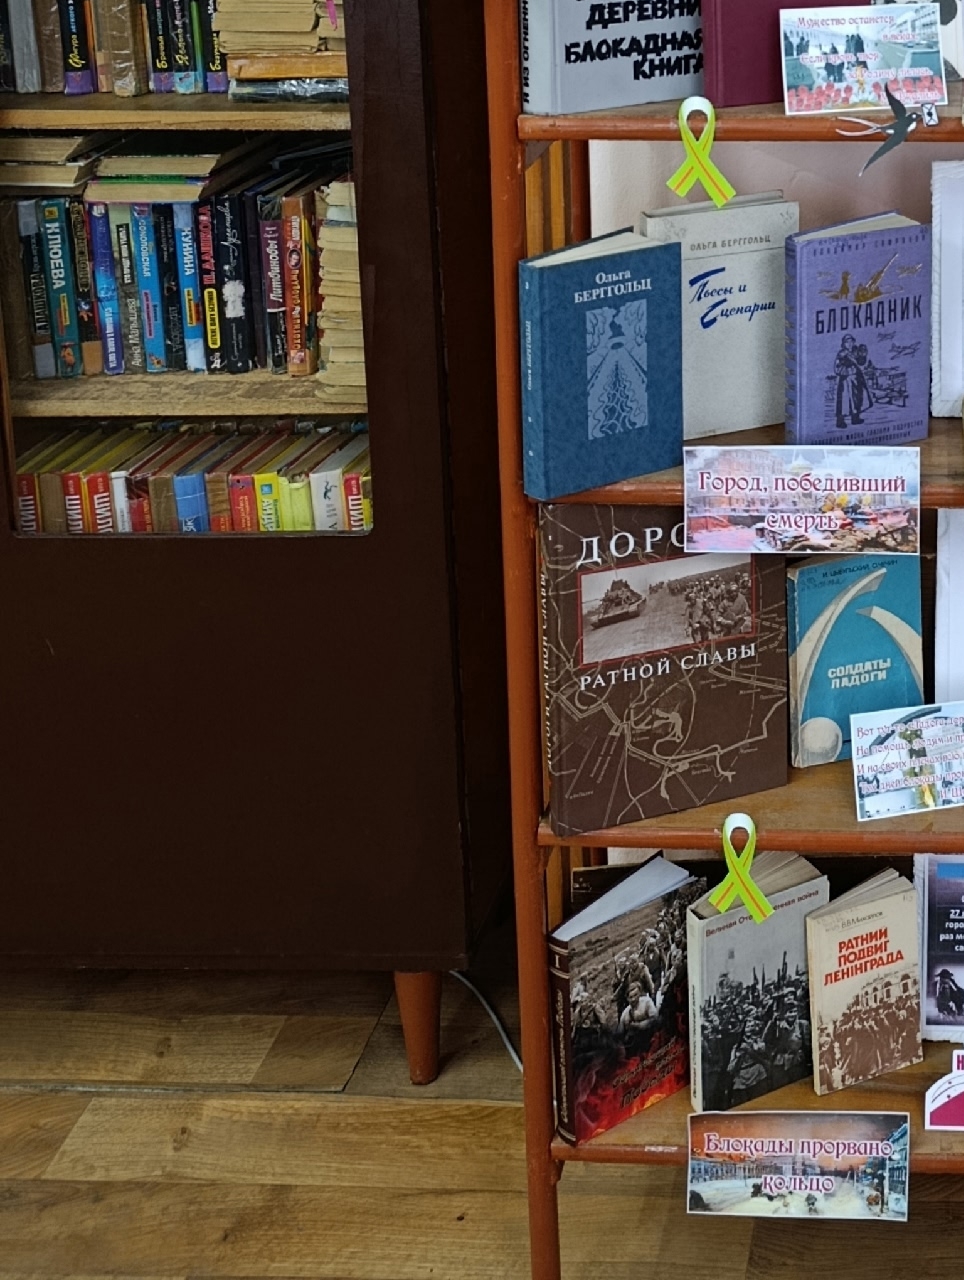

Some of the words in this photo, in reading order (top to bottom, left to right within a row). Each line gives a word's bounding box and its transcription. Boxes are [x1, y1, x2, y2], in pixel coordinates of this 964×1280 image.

[797, 18, 846, 30] Мужество
[68, 34, 86, 68] Фигура
[521, 67, 531, 86] ИЗ
[522, 92, 531, 104] Я
[199, 206, 215, 271] ДАШКОВА
[689, 239, 719, 252] ОЛЬГА
[719, 234, 771, 250] БЕРГГОЛЬЦ
[45, 222, 67, 290] КЛЮЕВА
[594, 268, 631, 288] Ольга
[688, 266, 735, 305] Пьесы
[737, 283, 748, 296] и
[573, 278, 653, 304] БЕРГГОЛЬЦ
[126, 297, 139, 344] Малышева
[700, 299, 777, 329] Сценарии
[815, 294, 922, 336] БЛОКАДНИК
[129, 345, 143, 367] Анна
[698, 470, 769, 496] Город,
[773, 471, 907, 496] победивший
[765, 511, 839, 533] смерть
[681, 641, 758, 671] СЛАВЫ
[580, 657, 672, 692] РАТНОЙ
[827, 657, 892, 678] СОЛДАТЫ
[831, 670, 888, 690] ЛАДОГИ
[856, 726, 875, 740] Вот
[857, 764, 865, 775] И
[949, 909, 961, 919] 27
[705, 919, 738, 937] Великая
[939, 933, 954, 942] раз
[838, 939, 890, 968] ПОДВИГ
[705, 1132, 794, 1157] Блокады
[799, 1139, 894, 1160] прорвано
[761, 1174, 835, 1195] кольцо
